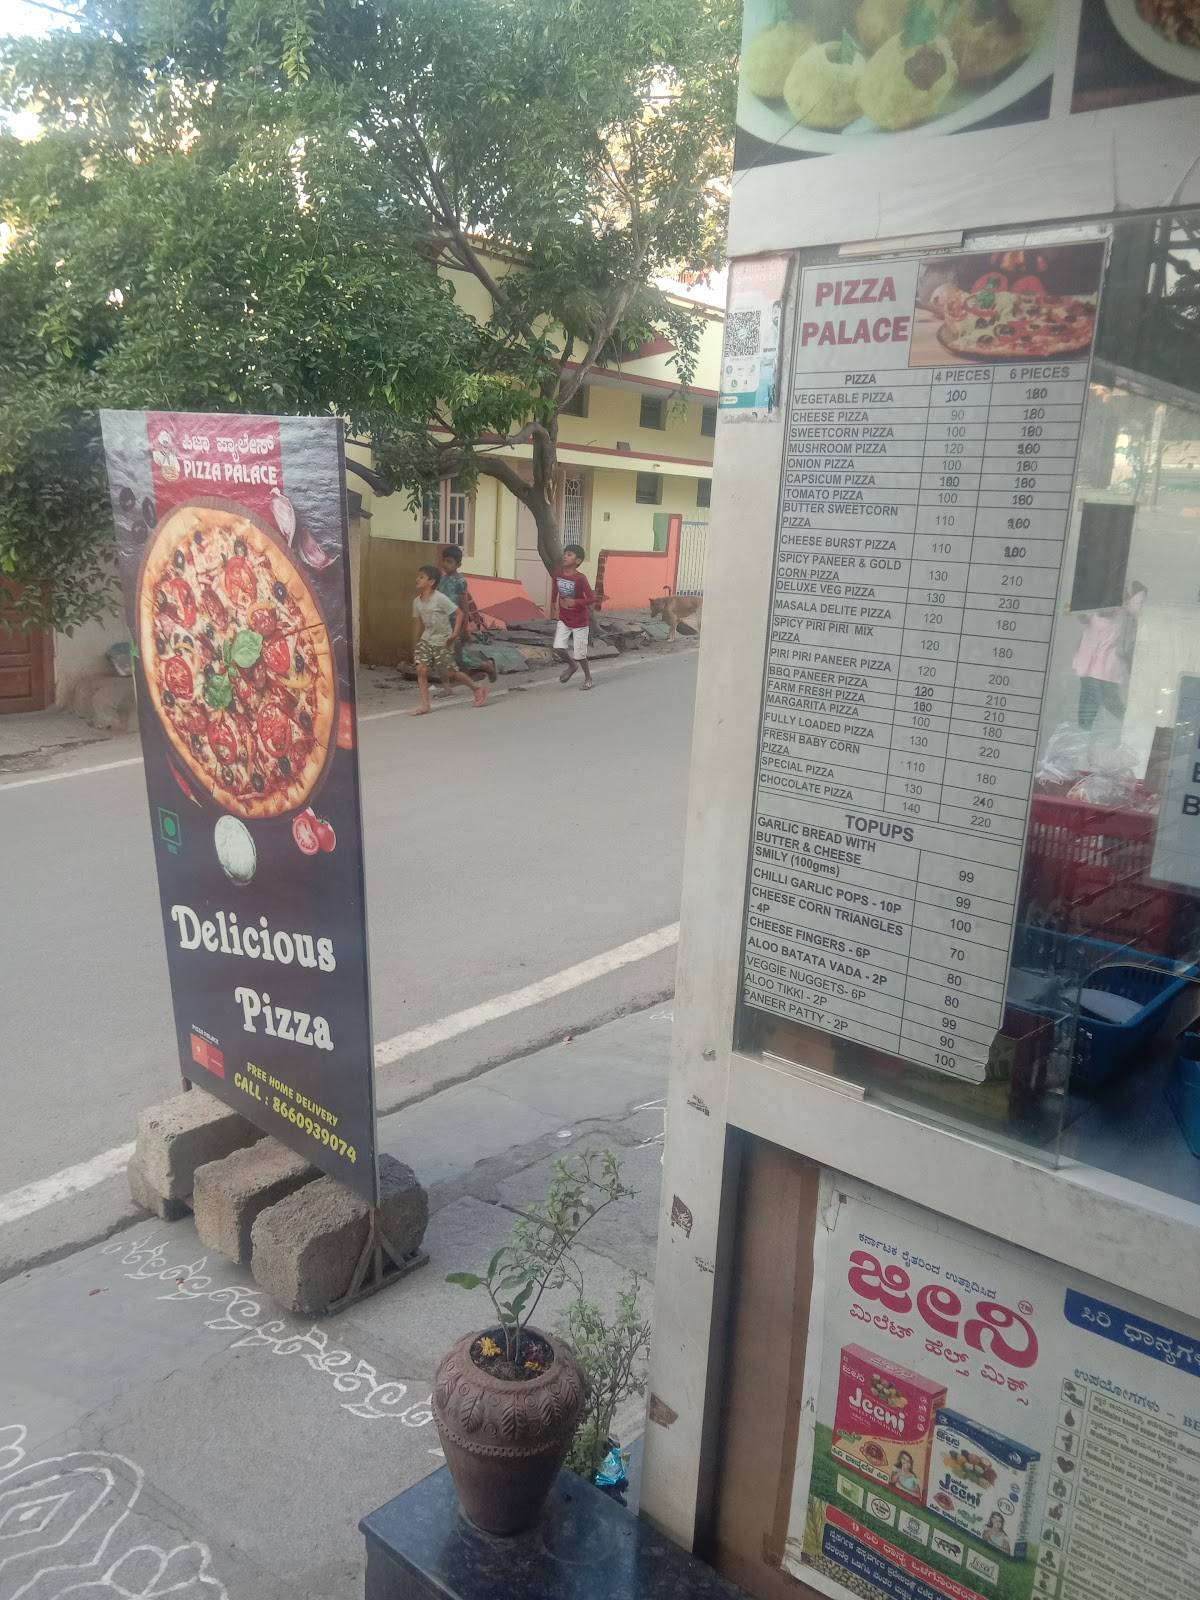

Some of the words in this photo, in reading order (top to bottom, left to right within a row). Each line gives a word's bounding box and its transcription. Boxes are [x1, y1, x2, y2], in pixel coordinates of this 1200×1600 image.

[815, 276, 896, 307] PIZZA
[801, 316, 911, 346] PALACE
[844, 373, 876, 385] PIZZA
[935, 372, 941, 380] 4
[946, 369, 990, 381] PIECES
[1010, 369, 1016, 379] 6
[1021, 367, 1070, 379] PIECES
[794, 393, 858, 404] VEGETABLE
[862, 392, 894, 402] PIZZA
[792, 412, 834, 422] CHEESE
[838, 411, 869, 421] PIZZA
[952, 410, 964, 420] 90
[791, 428, 858, 438] SWEETCORN
[862, 427, 894, 437] PIZZA
[946, 427, 965, 437] 100
[789, 443, 852, 454] MUSHROOM
[856, 443, 887, 453] PIZZA
[944, 444, 963, 454] 120
[788, 458, 821, 469] ONION
[824, 458, 854, 469] PIZZA
[942, 460, 961, 470] 100
[184, 460, 221, 482] PIZZA
[224, 463, 277, 485] PALACE
[786, 474, 841, 485] CAPSICUM
[844, 475, 876, 485] PIZZA
[785, 489, 829, 500] TOMATO
[833, 490, 863, 500] PIZZA
[938, 493, 957, 503] 100
[783, 502, 824, 513] BUTTER
[828, 505, 898, 516] SWEETCORN
[783, 517, 811, 527] PIZZA
[936, 516, 955, 526] 110
[781, 535, 822, 546] CHEESE
[825, 537, 862, 548] BURST
[865, 540, 896, 550] PIZZA
[932, 544, 951, 554] 110
[779, 553, 810, 564] SPICY
[813, 555, 855, 567] PANEER
[870, 559, 901, 570] GOLD
[778, 568, 807, 578] CORN
[810, 570, 840, 581] PIZZA
[929, 571, 948, 581] 130
[1001, 575, 1023, 586] 210
[776, 580, 816, 592] DELUXE
[820, 584, 841, 595] VEG
[845, 586, 875, 598] PIZZA
[927, 593, 945, 603] 130
[998, 598, 1020, 610] 230
[775, 600, 817, 613] MASALA
[820, 604, 857, 616] DELITE
[860, 608, 891, 619] PIZZA
[924, 614, 942, 624] 120
[774, 617, 802, 628] SPICY
[806, 621, 825, 632] PIRI
[829, 623, 849, 633] PIRI
[854, 626, 874, 636] MIX
[996, 620, 1016, 631] 180
[772, 631, 800, 642] PIZZA
[921, 640, 939, 651] 120
[992, 648, 1013, 659] 180
[770, 648, 789, 659] PIRI
[792, 651, 811, 662] PIRI
[814, 653, 857, 668] PANEER
[860, 658, 891, 672] PIZZA
[769, 666, 790, 677] BBQ
[793, 670, 835, 684] PANEER
[838, 676, 868, 688] PIZZA
[918, 666, 936, 677] 120
[988, 674, 1010, 686] 200
[768, 680, 796, 692] FARM
[798, 684, 832, 698] FRESH
[836, 690, 865, 702] PIZZA
[766, 694, 827, 711] MARGARITA
[830, 703, 859, 716] PIZZA
[986, 695, 1006, 707] 210
[912, 716, 930, 727] 100
[984, 711, 1005, 722] 210
[765, 712, 796, 725] FULLY
[800, 718, 841, 733] LOADED
[844, 725, 874, 738] PIZZA
[982, 727, 1002, 738] 180
[763, 729, 796, 742] FRESH
[799, 736, 826, 748] BABY
[830, 740, 860, 754] CORN
[910, 736, 928, 747] 130
[762, 742, 790, 755] PIZZA
[979, 747, 1000, 759] 220
[761, 756, 802, 772] SPECIAL
[806, 765, 834, 778] PIZZA
[907, 761, 925, 772] 110
[977, 774, 996, 785] 180
[760, 774, 821, 794] CHOCOLATE
[824, 786, 853, 800] PIZZA
[905, 784, 922, 795] 130
[902, 802, 920, 814] 140
[973, 796, 994, 808] 240
[845, 814, 914, 842] TOPUPS
[971, 816, 991, 828] 220
[758, 816, 799, 834] GARLIC
[802, 827, 842, 844] BREAD
[846, 836, 876, 852] WITH
[756, 831, 800, 849] BUTTER
[814, 845, 862, 865] CHEESE
[755, 846, 789, 862] SMILY
[791, 854, 840, 877] (100gms)
[959, 871, 974, 883] 99
[754, 868, 788, 884] CHILLI
[791, 877, 833, 896] GARLIC
[836, 889, 869, 906] POPS
[880, 900, 902, 913] 10P
[757, 903, 770, 913] 4P
[956, 897, 971, 909] 99
[752, 887, 795, 907] CHEESE
[799, 899, 831, 916] CORN
[834, 908, 903, 936] TRIANGLES
[950, 918, 972, 933] 100
[171, 904, 336, 972] Delicious
[750, 916, 793, 937] CHEESE
[796, 930, 846, 952] FINGERS
[856, 947, 871, 958] 6P
[748, 936, 778, 952] ALOO
[782, 946, 826, 968] BATATA
[830, 960, 862, 979] VADA
[872, 973, 887, 985] 2P
[950, 948, 965, 961] 70
[747, 955, 787, 977] VEGGIE
[851, 990, 866, 1000] 6P
[947, 973, 962, 986] 80
[744, 972, 774, 990] ALOO
[777, 982, 804, 1000] TIKKI
[813, 994, 828, 1006] 2P
[944, 996, 959, 1008] 80
[743, 989, 786, 1011] PANEER
[789, 1003, 824, 1023] PATTY
[834, 1019, 848, 1031] 2P
[234, 986, 334, 1051] Pizza
[942, 1017, 957, 1030] 99
[940, 1035, 954, 1048] 90
[934, 1053, 956, 1068] 100
[247, 1062, 267, 1082] FREE
[269, 1076, 293, 1097] HOME
[296, 1093, 338, 1127] DELIVERY
[234, 1072, 261, 1101] CALL
[273, 1096, 357, 1164] 8660939074
[848, 1250, 1039, 1369] ಜೀನಿ
[848, 1388, 905, 1433] Jeeni
